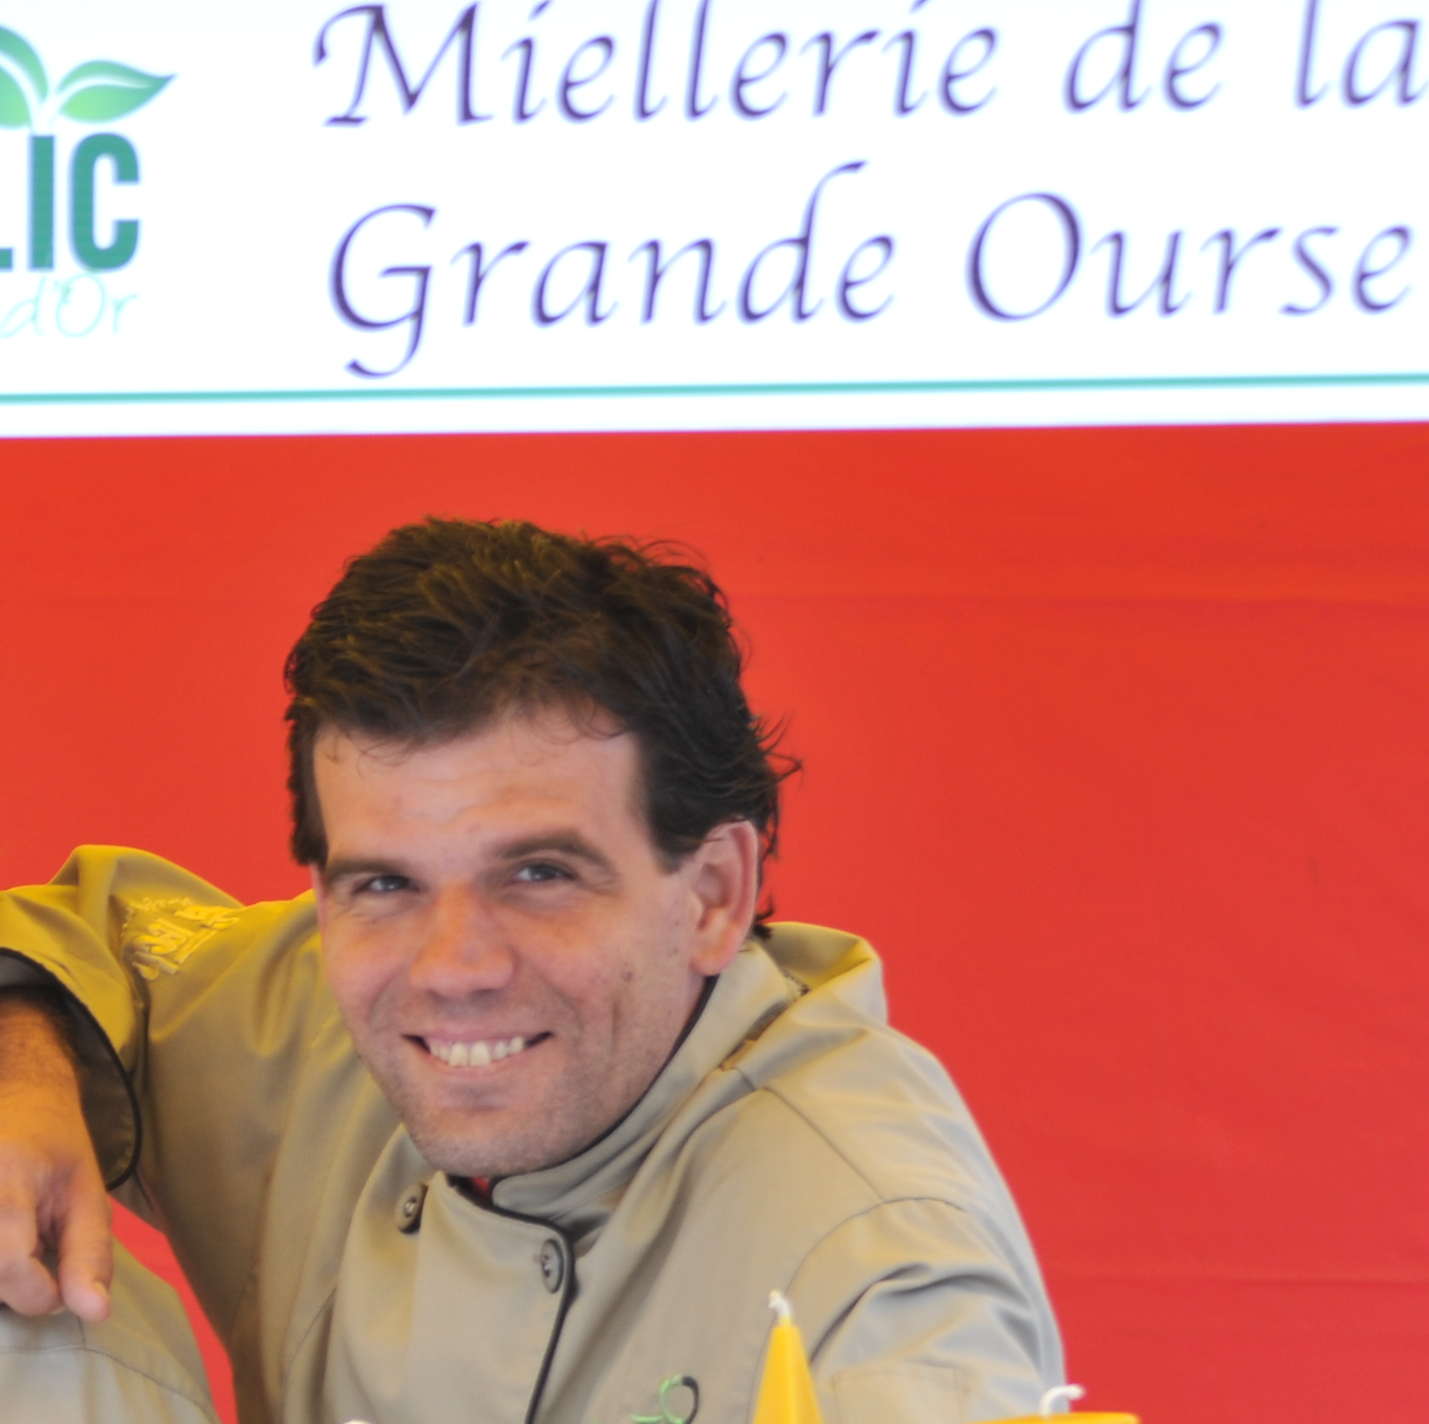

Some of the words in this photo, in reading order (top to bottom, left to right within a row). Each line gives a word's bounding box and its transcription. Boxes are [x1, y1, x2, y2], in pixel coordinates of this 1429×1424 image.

[312, 0, 999, 126] Miellerie
[1063, 0, 1225, 114] de
[1294, 0, 1427, 110] la
[327, 160, 899, 381] Grande
[965, 190, 1413, 324] Ourse
